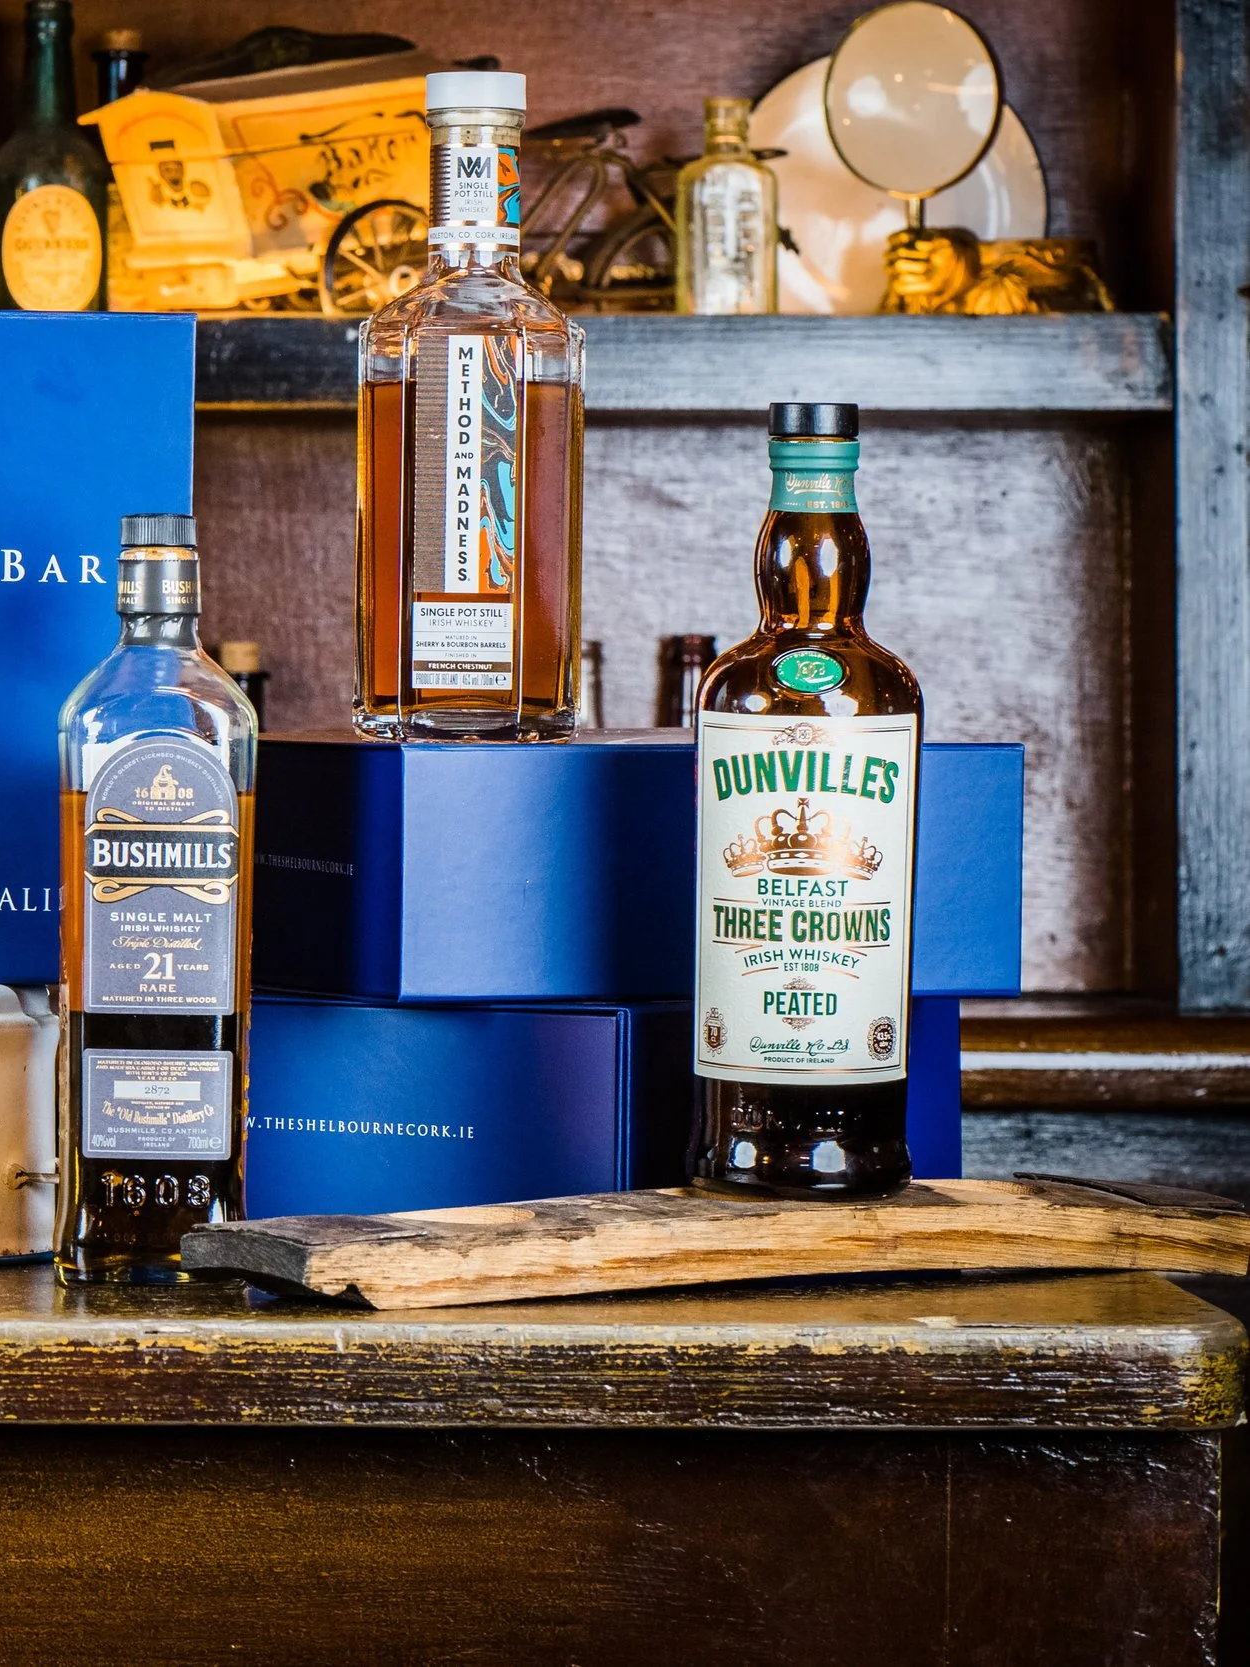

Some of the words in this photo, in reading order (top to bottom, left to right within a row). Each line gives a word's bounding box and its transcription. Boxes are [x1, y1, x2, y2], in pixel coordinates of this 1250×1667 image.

[458, 346, 474, 445] METHOD
[0, 549, 108, 584] BAR
[420, 608, 454, 616] SINGLE
[458, 608, 477, 617] POT
[480, 609, 502, 618] STILL
[416, 673, 434, 685] PRODUCT
[442, 674, 458, 685] IRELAND
[118, 758, 140, 774] OLDEST
[141, 752, 174, 760] LICENSED
[176, 755, 202, 770] WHISKEY
[712, 750, 899, 804] DUNVILLE'S
[178, 788, 194, 800] 08
[92, 838, 232, 868] BUSHMILLS
[758, 878, 848, 897] BELFAST
[762, 899, 806, 908] VINTAGE
[808, 900, 842, 908] BLEND
[110, 912, 166, 922] SINGLE
[173, 912, 212, 923] MALT
[713, 904, 784, 942] THREE
[791, 908, 890, 942] CROWNS
[112, 936, 150, 950] Triple
[152, 936, 203, 950] Distilled
[142, 952, 176, 980] 21
[744, 950, 784, 968] IRISH
[789, 948, 860, 968] WHISKEY
[784, 962, 798, 972] EST
[800, 963, 820, 972] 1808
[139, 984, 177, 993] RARE
[762, 990, 837, 1016] PEATED
[750, 1036, 801, 1052] Dunville
[144, 1085, 170, 1096] 2872
[102, 1100, 116, 1117] The
[172, 1109, 205, 1124] Distillery
[101, 1174, 212, 1209] 1608
